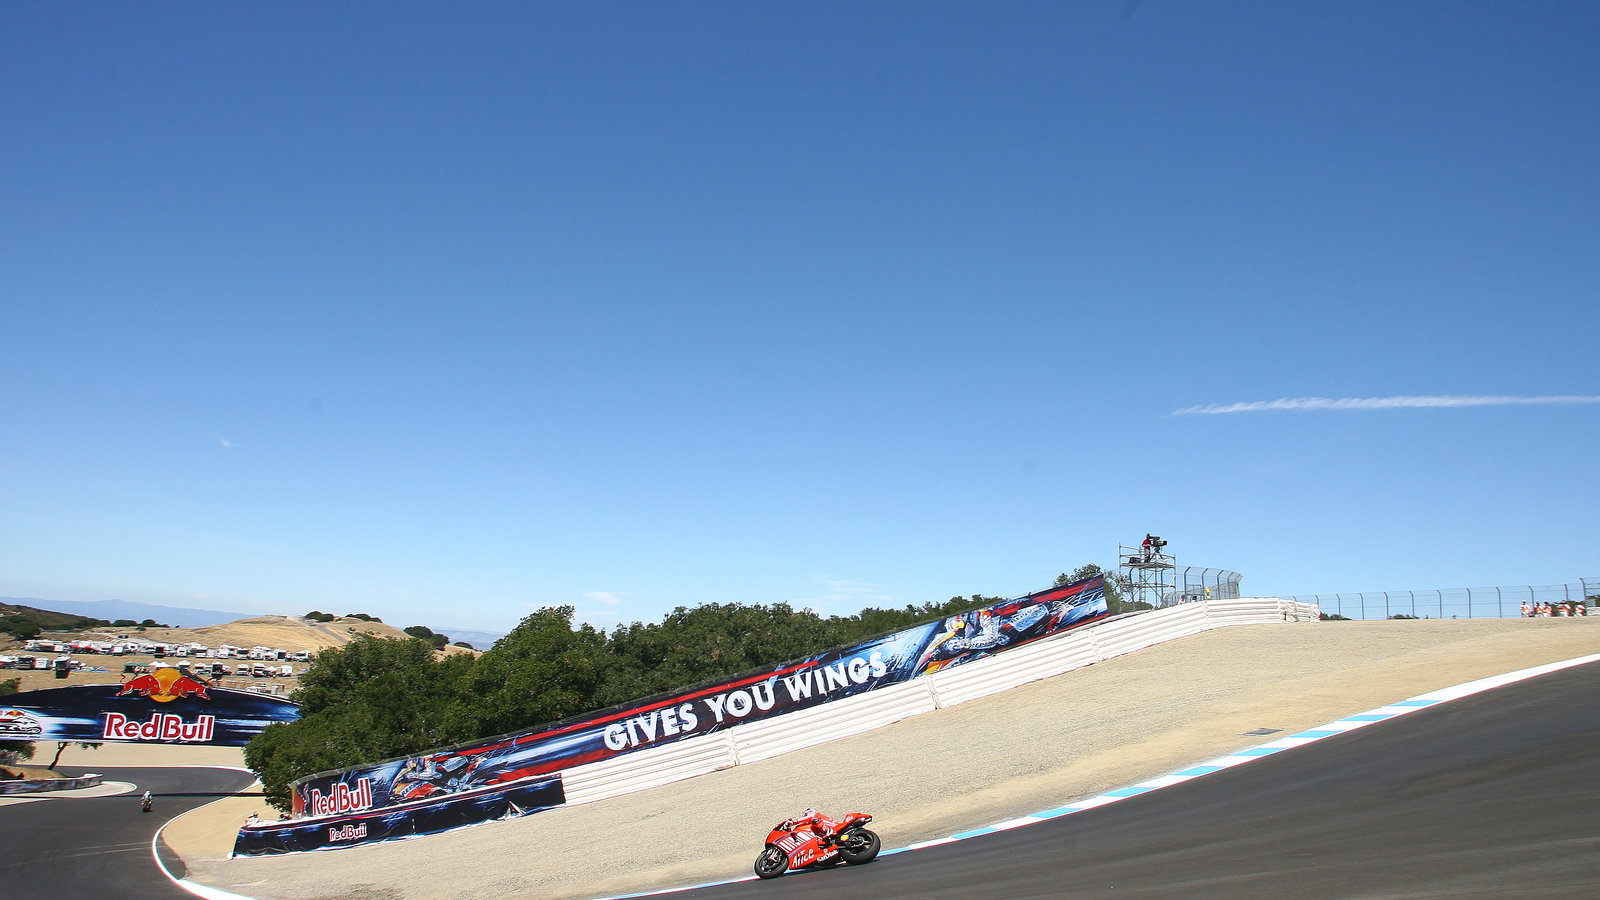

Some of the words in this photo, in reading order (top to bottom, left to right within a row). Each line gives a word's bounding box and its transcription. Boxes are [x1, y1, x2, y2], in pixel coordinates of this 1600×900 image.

[604, 703, 698, 751] GIVES
[704, 683, 775, 723] YOU
[783, 653, 887, 701] WINGS
[104, 713, 161, 740] Red
[311, 784, 336, 817] Red
[336, 778, 373, 813] Bull
[329, 827, 347, 842] Red
[347, 824, 367, 839] Bull
